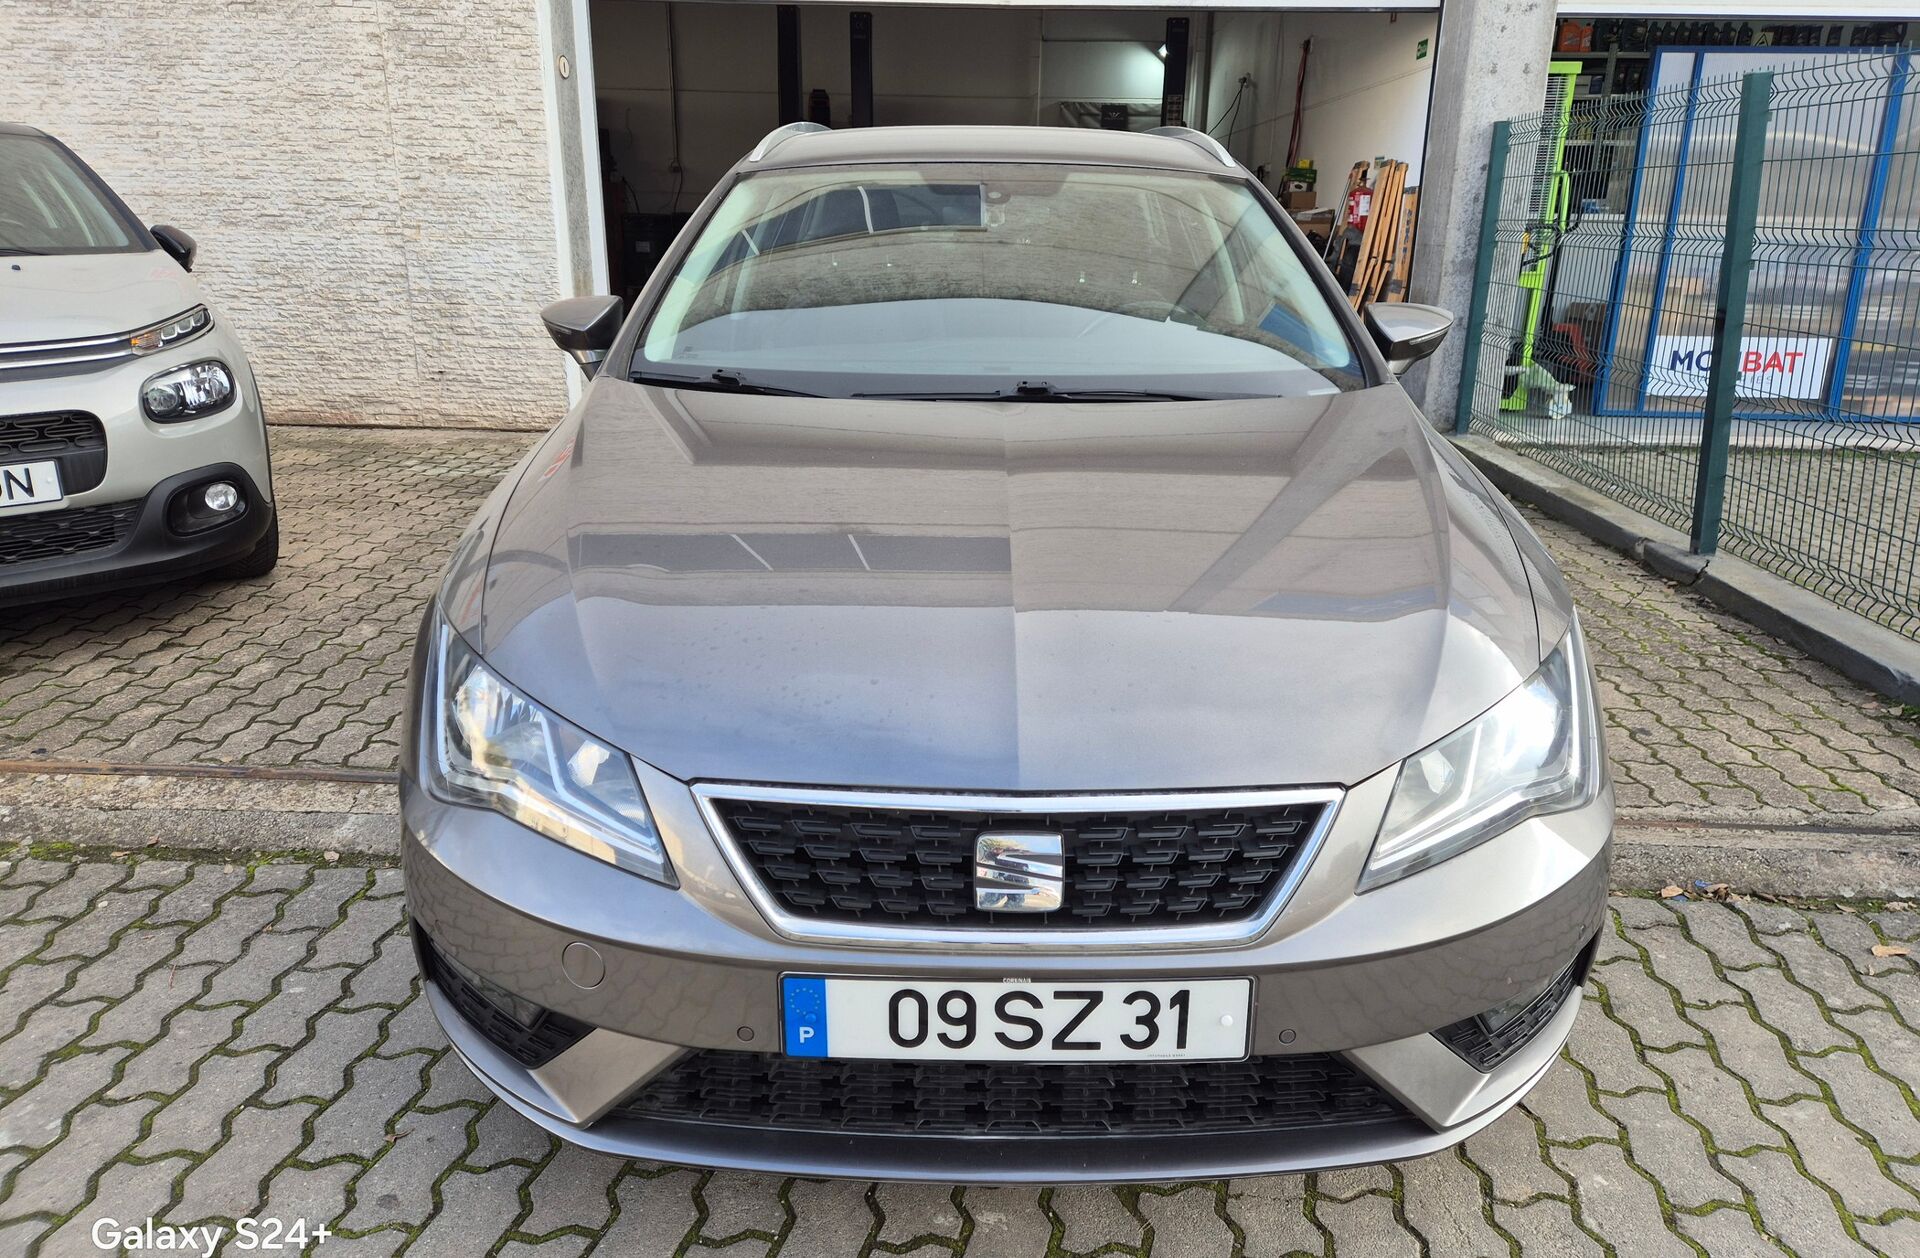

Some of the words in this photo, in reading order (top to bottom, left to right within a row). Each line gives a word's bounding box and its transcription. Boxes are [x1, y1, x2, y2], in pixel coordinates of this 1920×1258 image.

[1670, 349, 1803, 374] MOBAT
[0, 467, 35, 500] N
[888, 988, 977, 1049] 09
[994, 990, 1104, 1050] SZ
[1120, 989, 1190, 1050] 31
[799, 1026, 815, 1044] P
